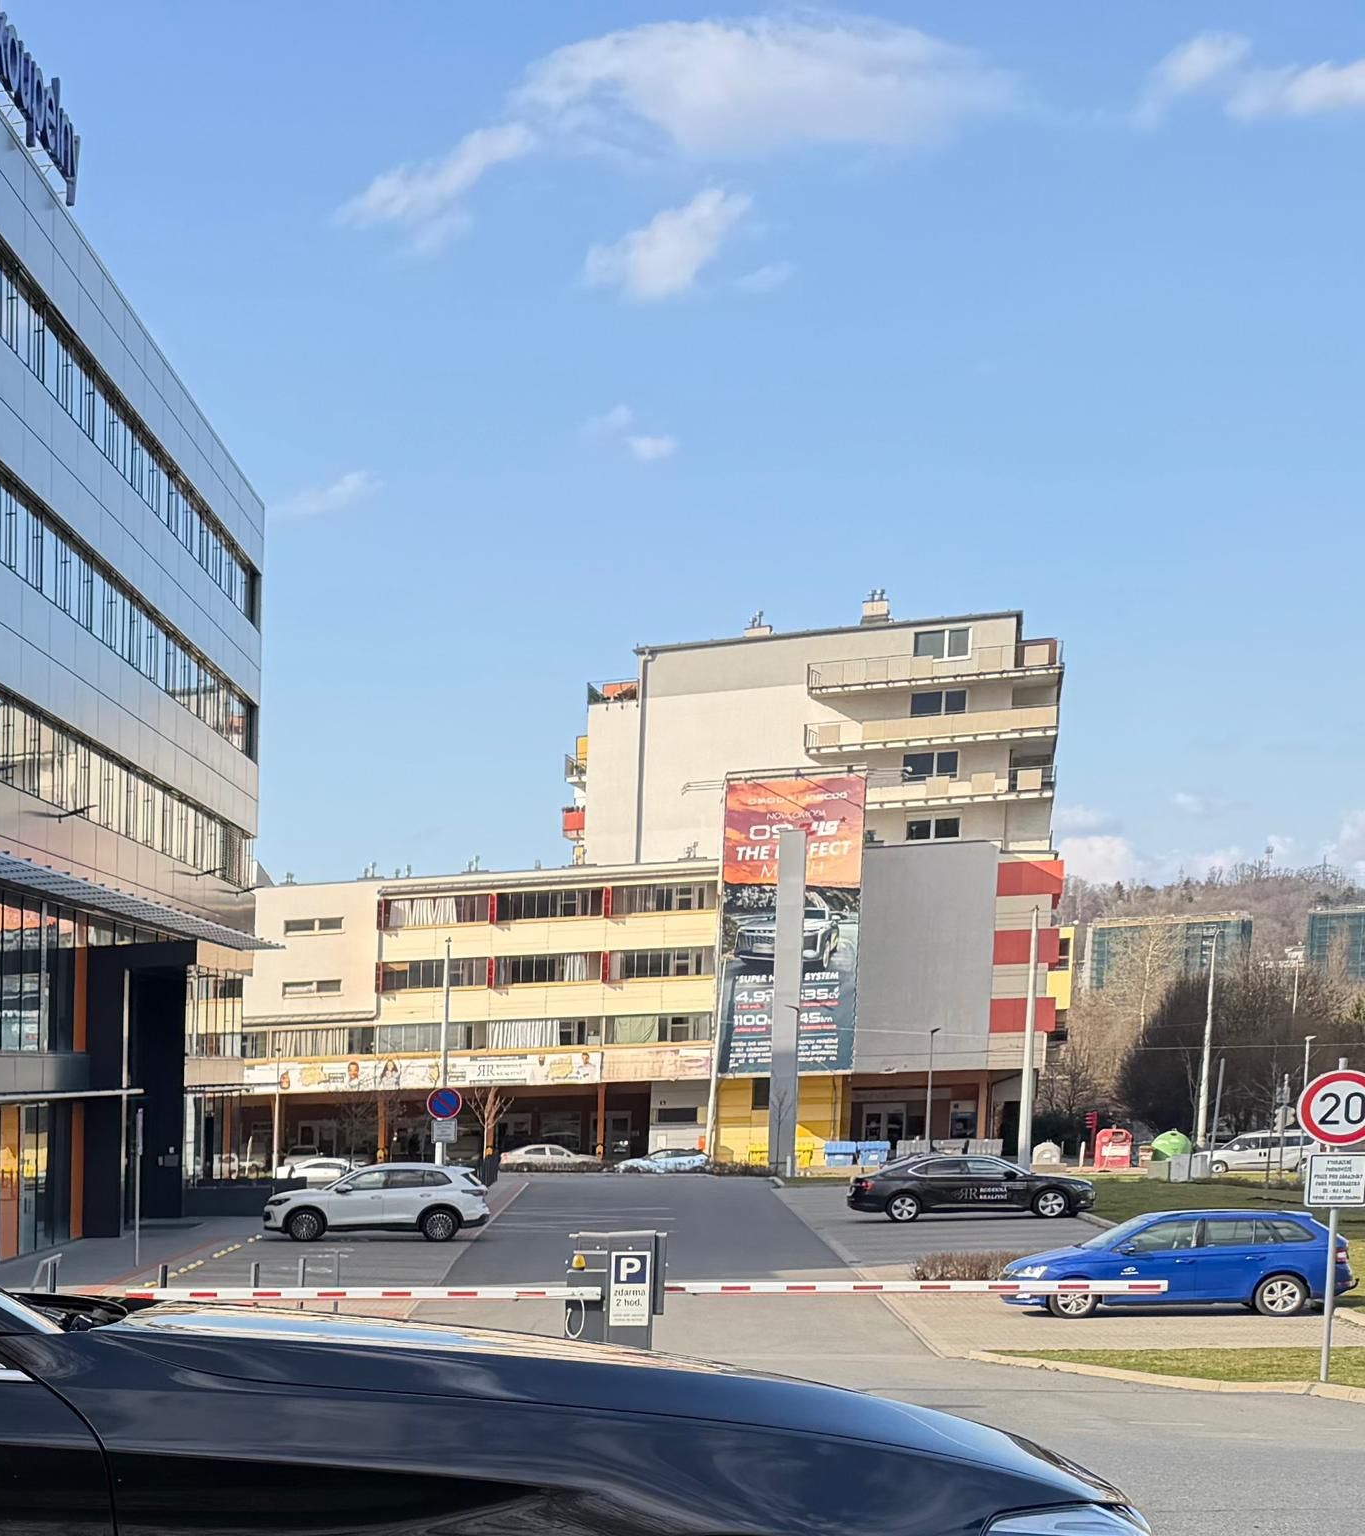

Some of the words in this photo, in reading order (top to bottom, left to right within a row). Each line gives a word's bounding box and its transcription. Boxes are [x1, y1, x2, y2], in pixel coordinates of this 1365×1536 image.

[736, 845, 770, 862] THE
[804, 972, 839, 981] SYSTEM
[1318, 1092, 1365, 1125] 20
[620, 1257, 642, 1281] P
[614, 1288, 646, 1297] zdarma
[616, 1298, 622, 1307] 2
[624, 1298, 643, 1307] hod.
